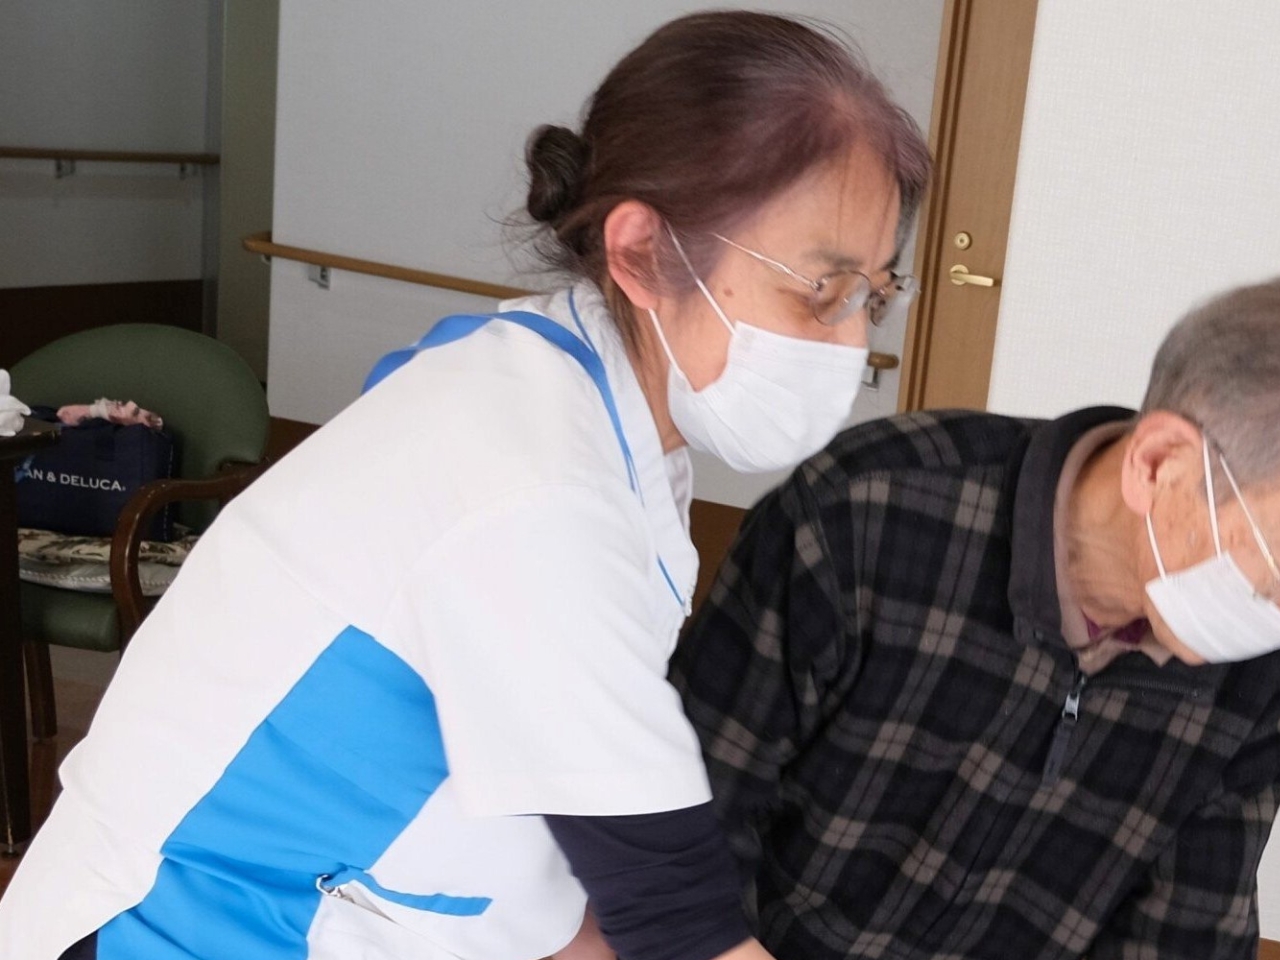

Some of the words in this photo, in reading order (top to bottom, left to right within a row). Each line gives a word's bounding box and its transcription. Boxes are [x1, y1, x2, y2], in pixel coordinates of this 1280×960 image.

[15, 466, 43, 480] AN
[45, 470, 56, 483] &
[60, 472, 122, 492] DELUCA
